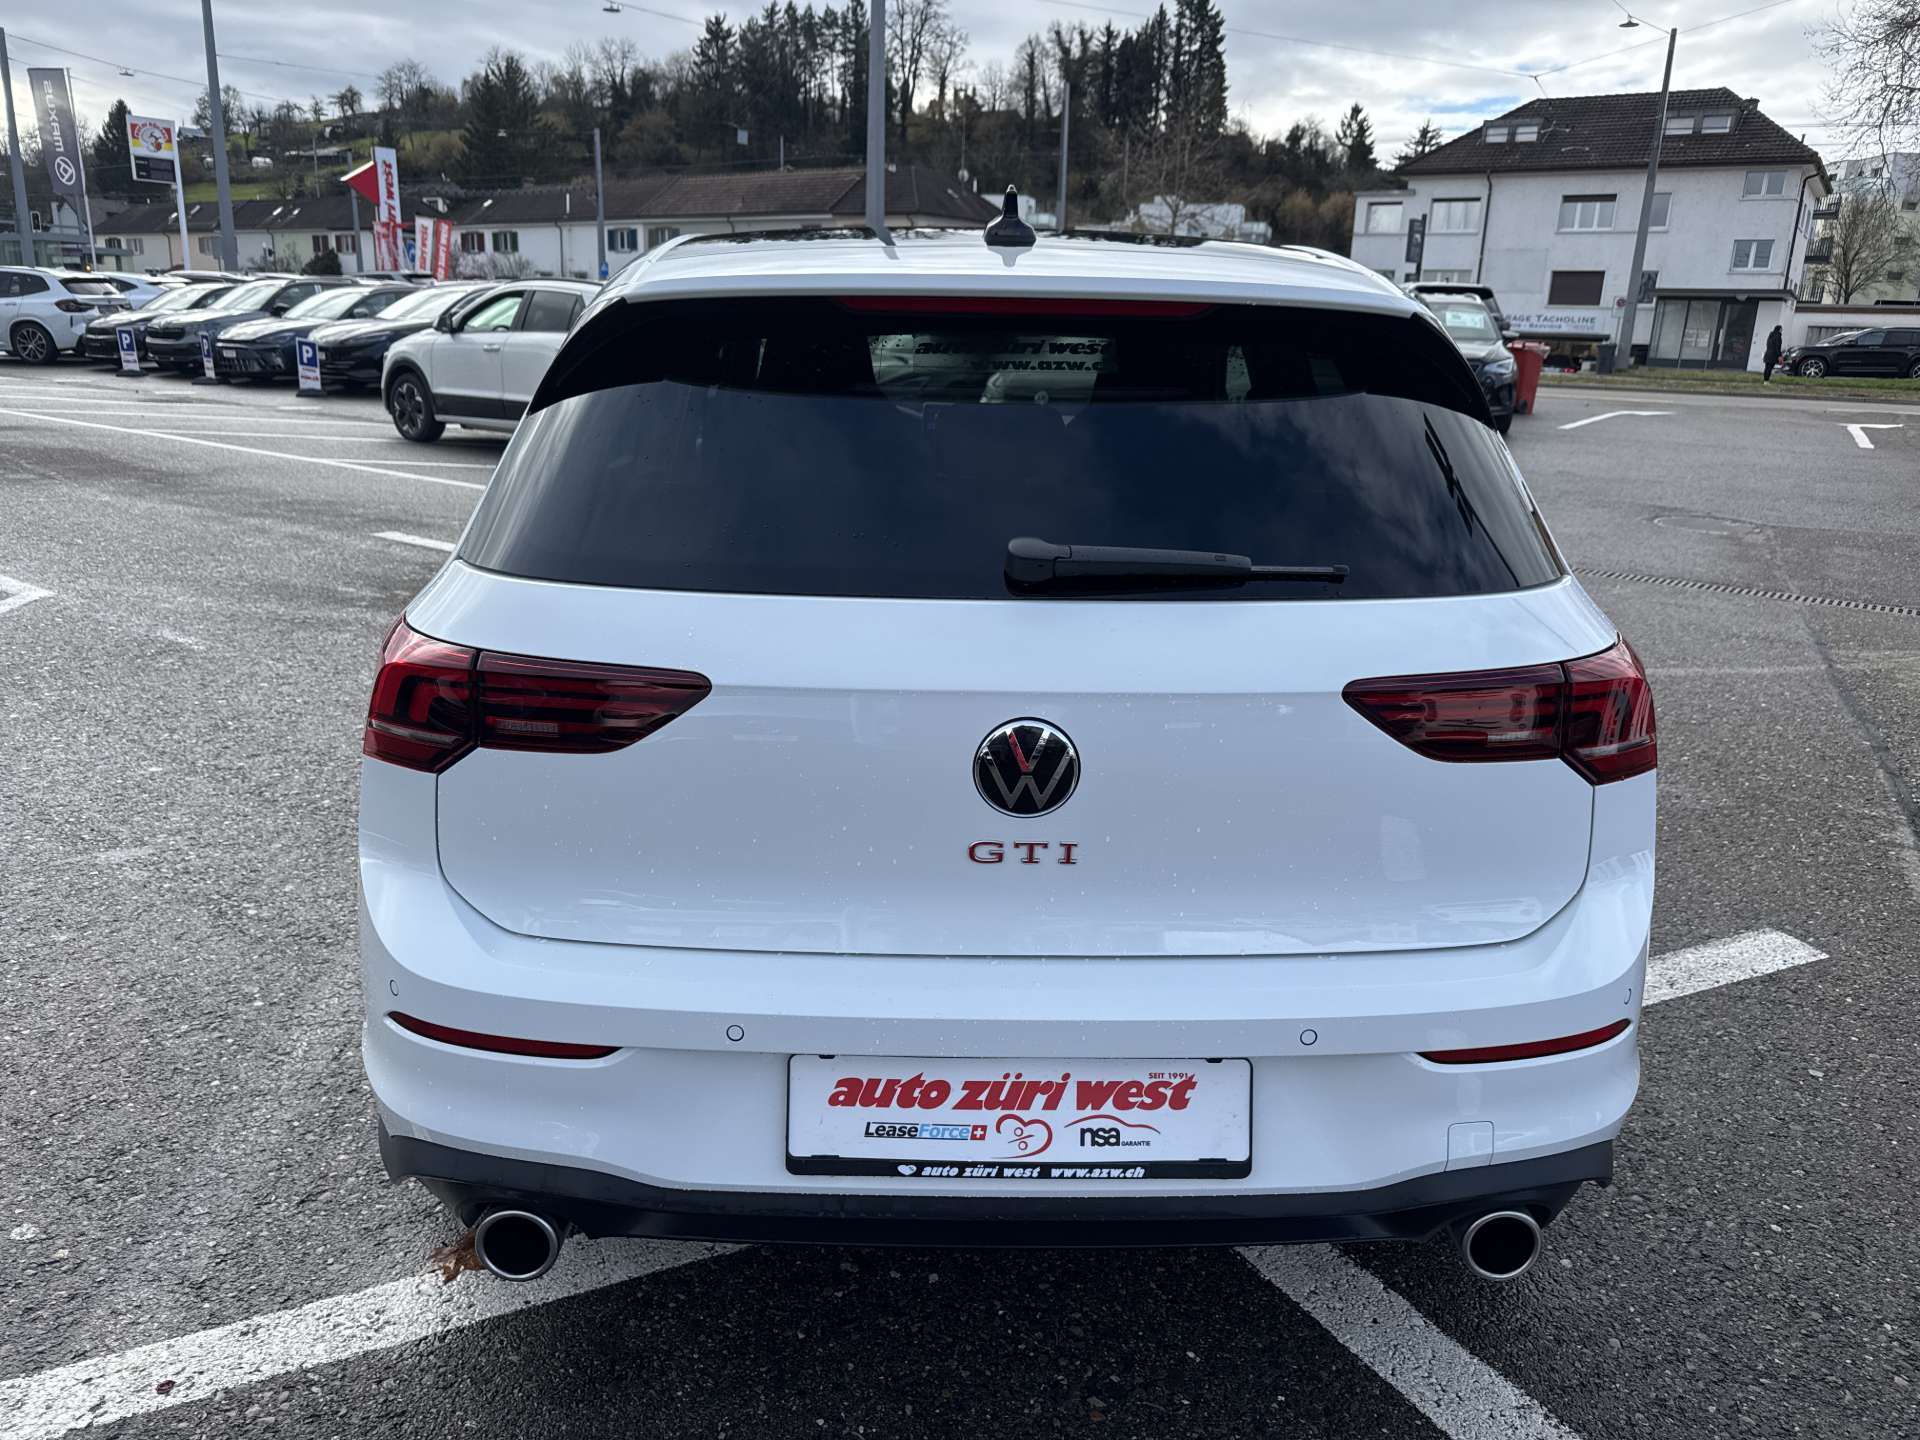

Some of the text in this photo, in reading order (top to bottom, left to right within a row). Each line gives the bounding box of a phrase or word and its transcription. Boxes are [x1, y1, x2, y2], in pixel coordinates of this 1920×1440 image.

[1535, 314, 1597, 325] TACHOLINE
[122, 333, 131, 350] P
[1049, 340, 1101, 355] wes
[302, 345, 313, 363] P
[967, 840, 1079, 864] GTI
[828, 1072, 1198, 1111] auto züri west
[864, 1121, 970, 1139] LeaseForce
[1080, 1127, 1121, 1148] nsa
[921, 1164, 1146, 1178] auto züri west www.azw.ch
